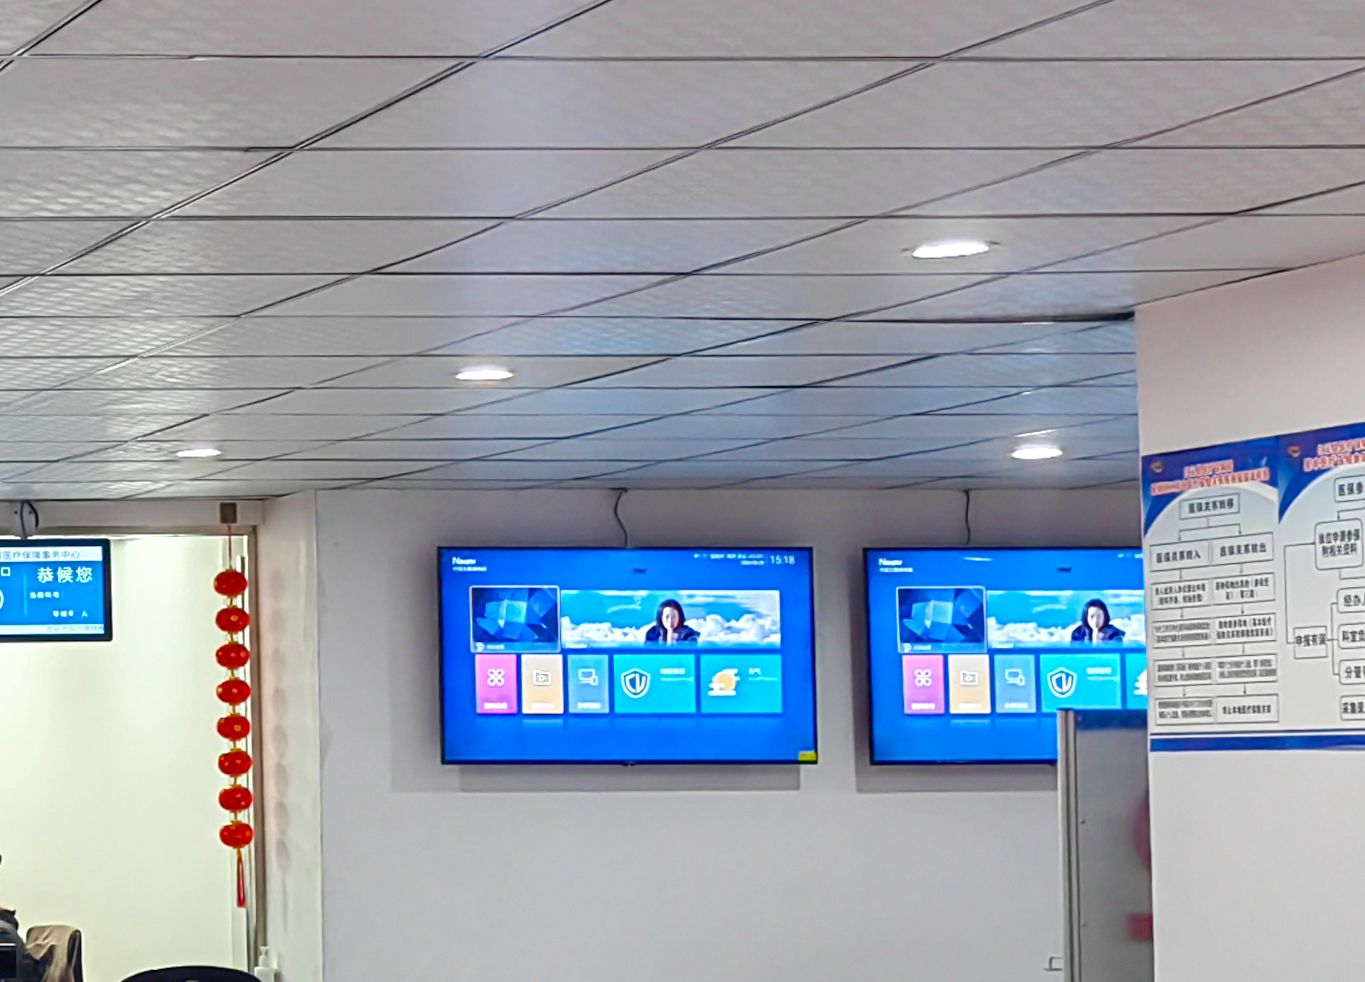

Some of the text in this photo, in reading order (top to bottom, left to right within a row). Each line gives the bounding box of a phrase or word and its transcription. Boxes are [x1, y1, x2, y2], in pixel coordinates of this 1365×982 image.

[770, 555, 796, 565] 15:18
[37, 567, 93, 583] 恭候您
